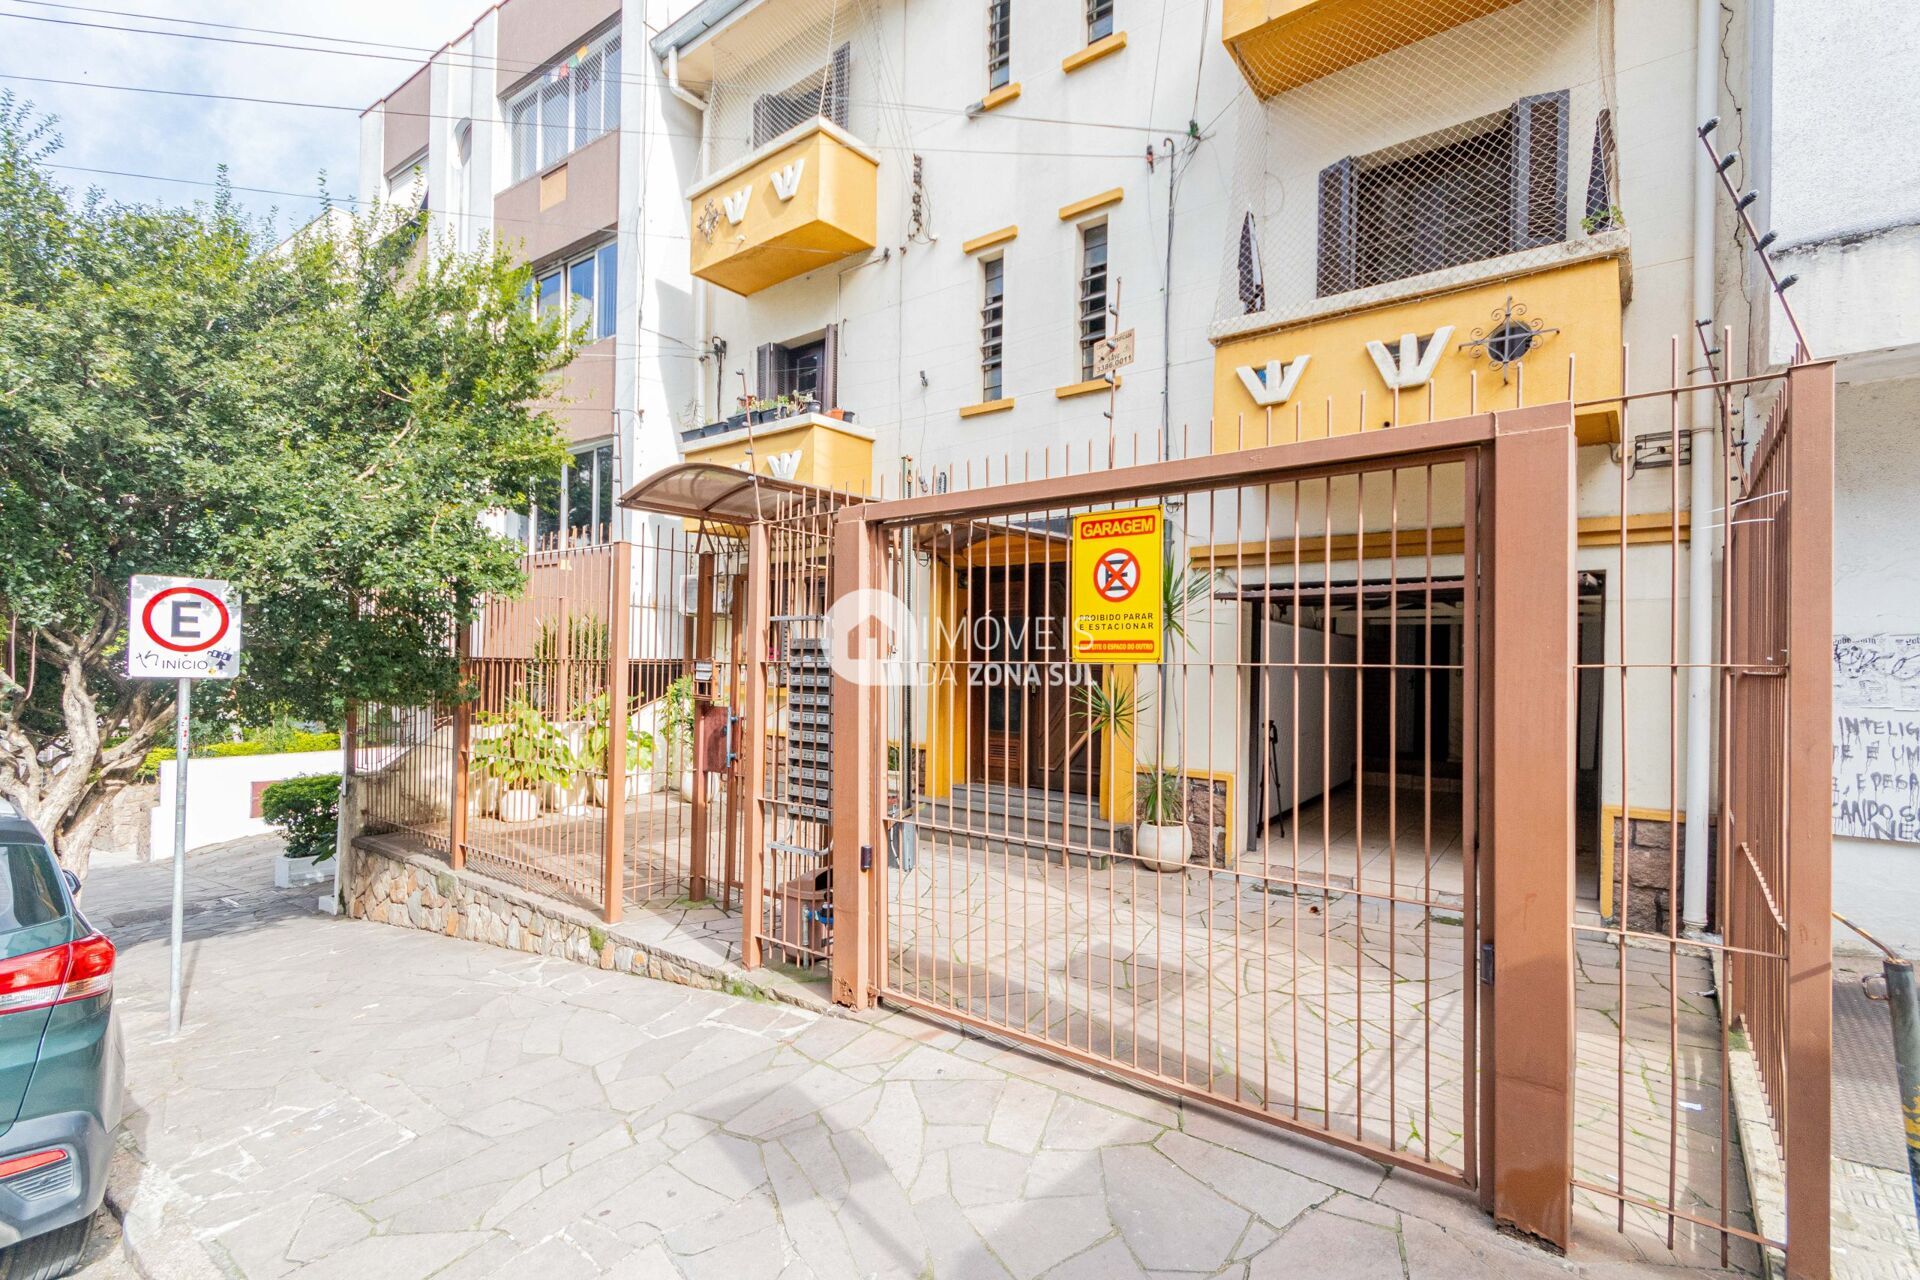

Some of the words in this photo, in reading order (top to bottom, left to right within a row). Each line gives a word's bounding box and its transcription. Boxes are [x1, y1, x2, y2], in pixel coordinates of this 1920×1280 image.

[1082, 518, 1154, 537] GARAGEM
[171, 600, 202, 638] E
[1123, 612, 1154, 621] PARAR
[1079, 623, 1085, 631] E
[1088, 622, 1154, 631] ESTACIONAR
[161, 657, 208, 670] INÍCIO
